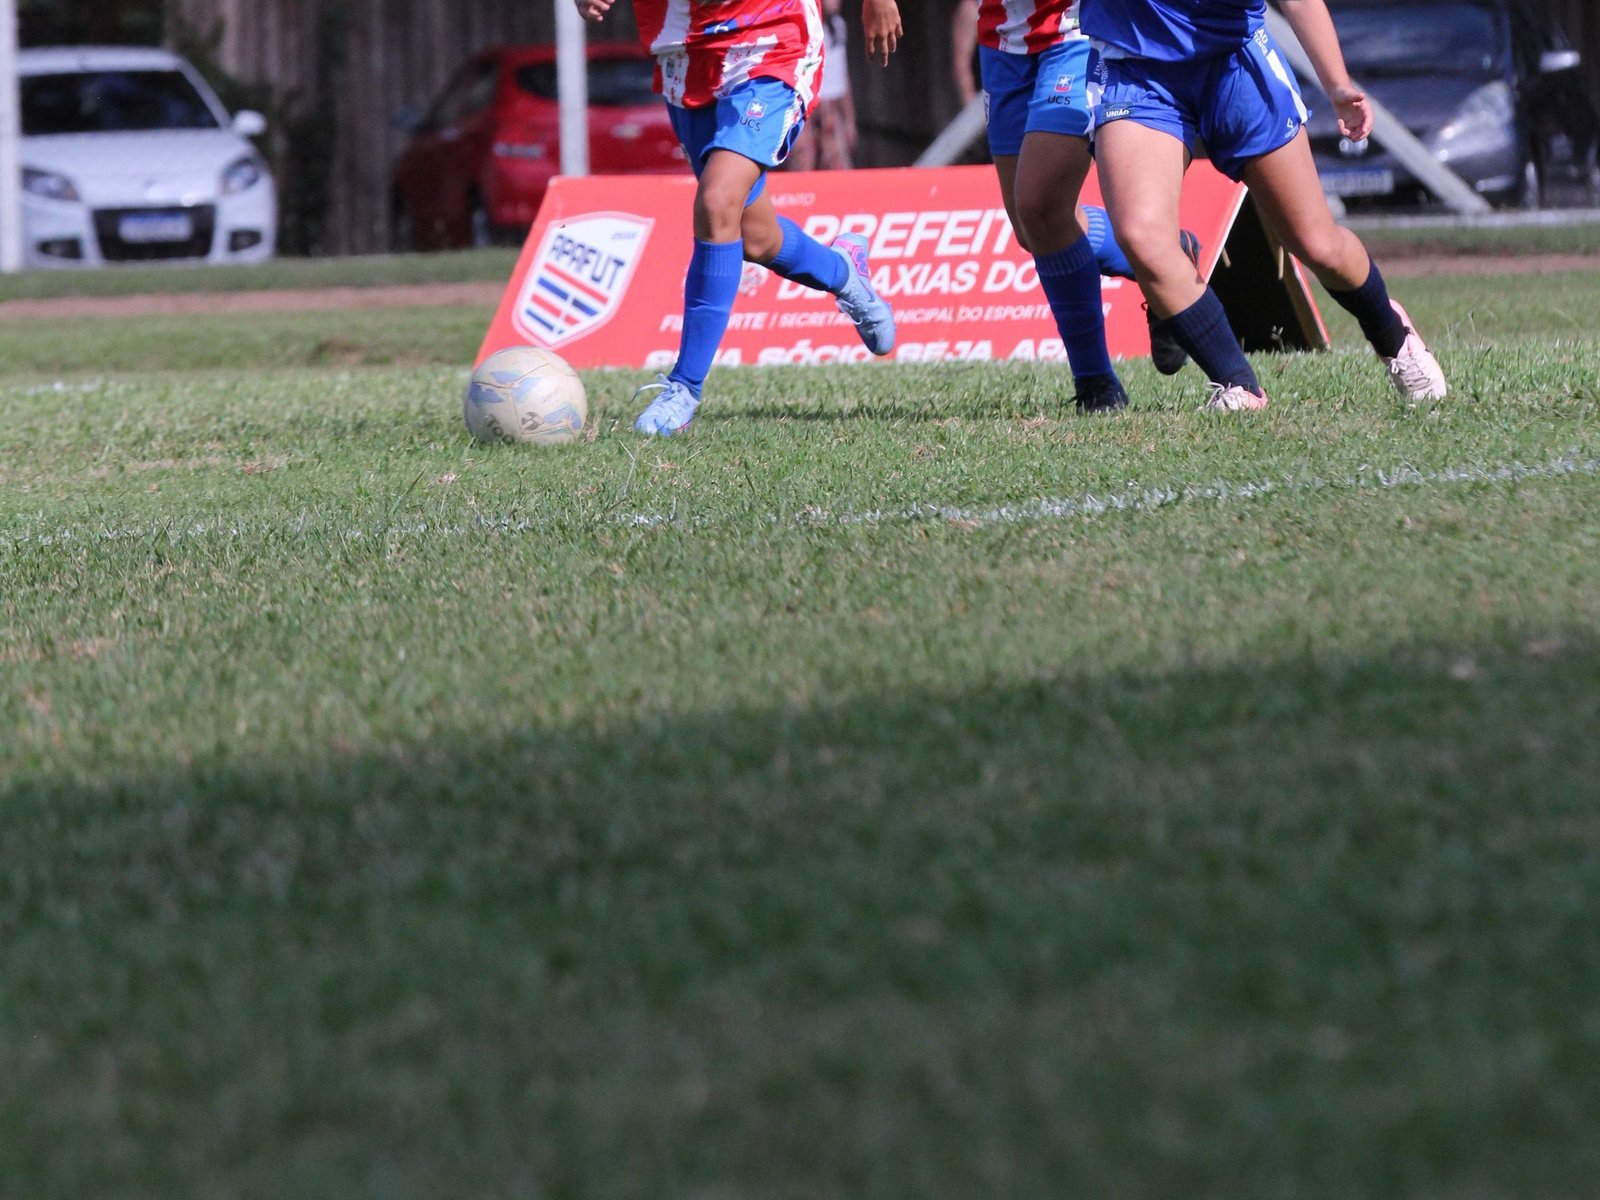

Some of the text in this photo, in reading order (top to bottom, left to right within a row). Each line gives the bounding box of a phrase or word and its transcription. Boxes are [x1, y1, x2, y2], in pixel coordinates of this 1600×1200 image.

[1047, 95, 1072, 106] UCS
[739, 115, 762, 133] UCS
[801, 209, 1016, 260] PREFEIT
[550, 233, 625, 291] APAFUT
[868, 260, 980, 297] AXIAS
[982, 259, 1040, 294] DO
